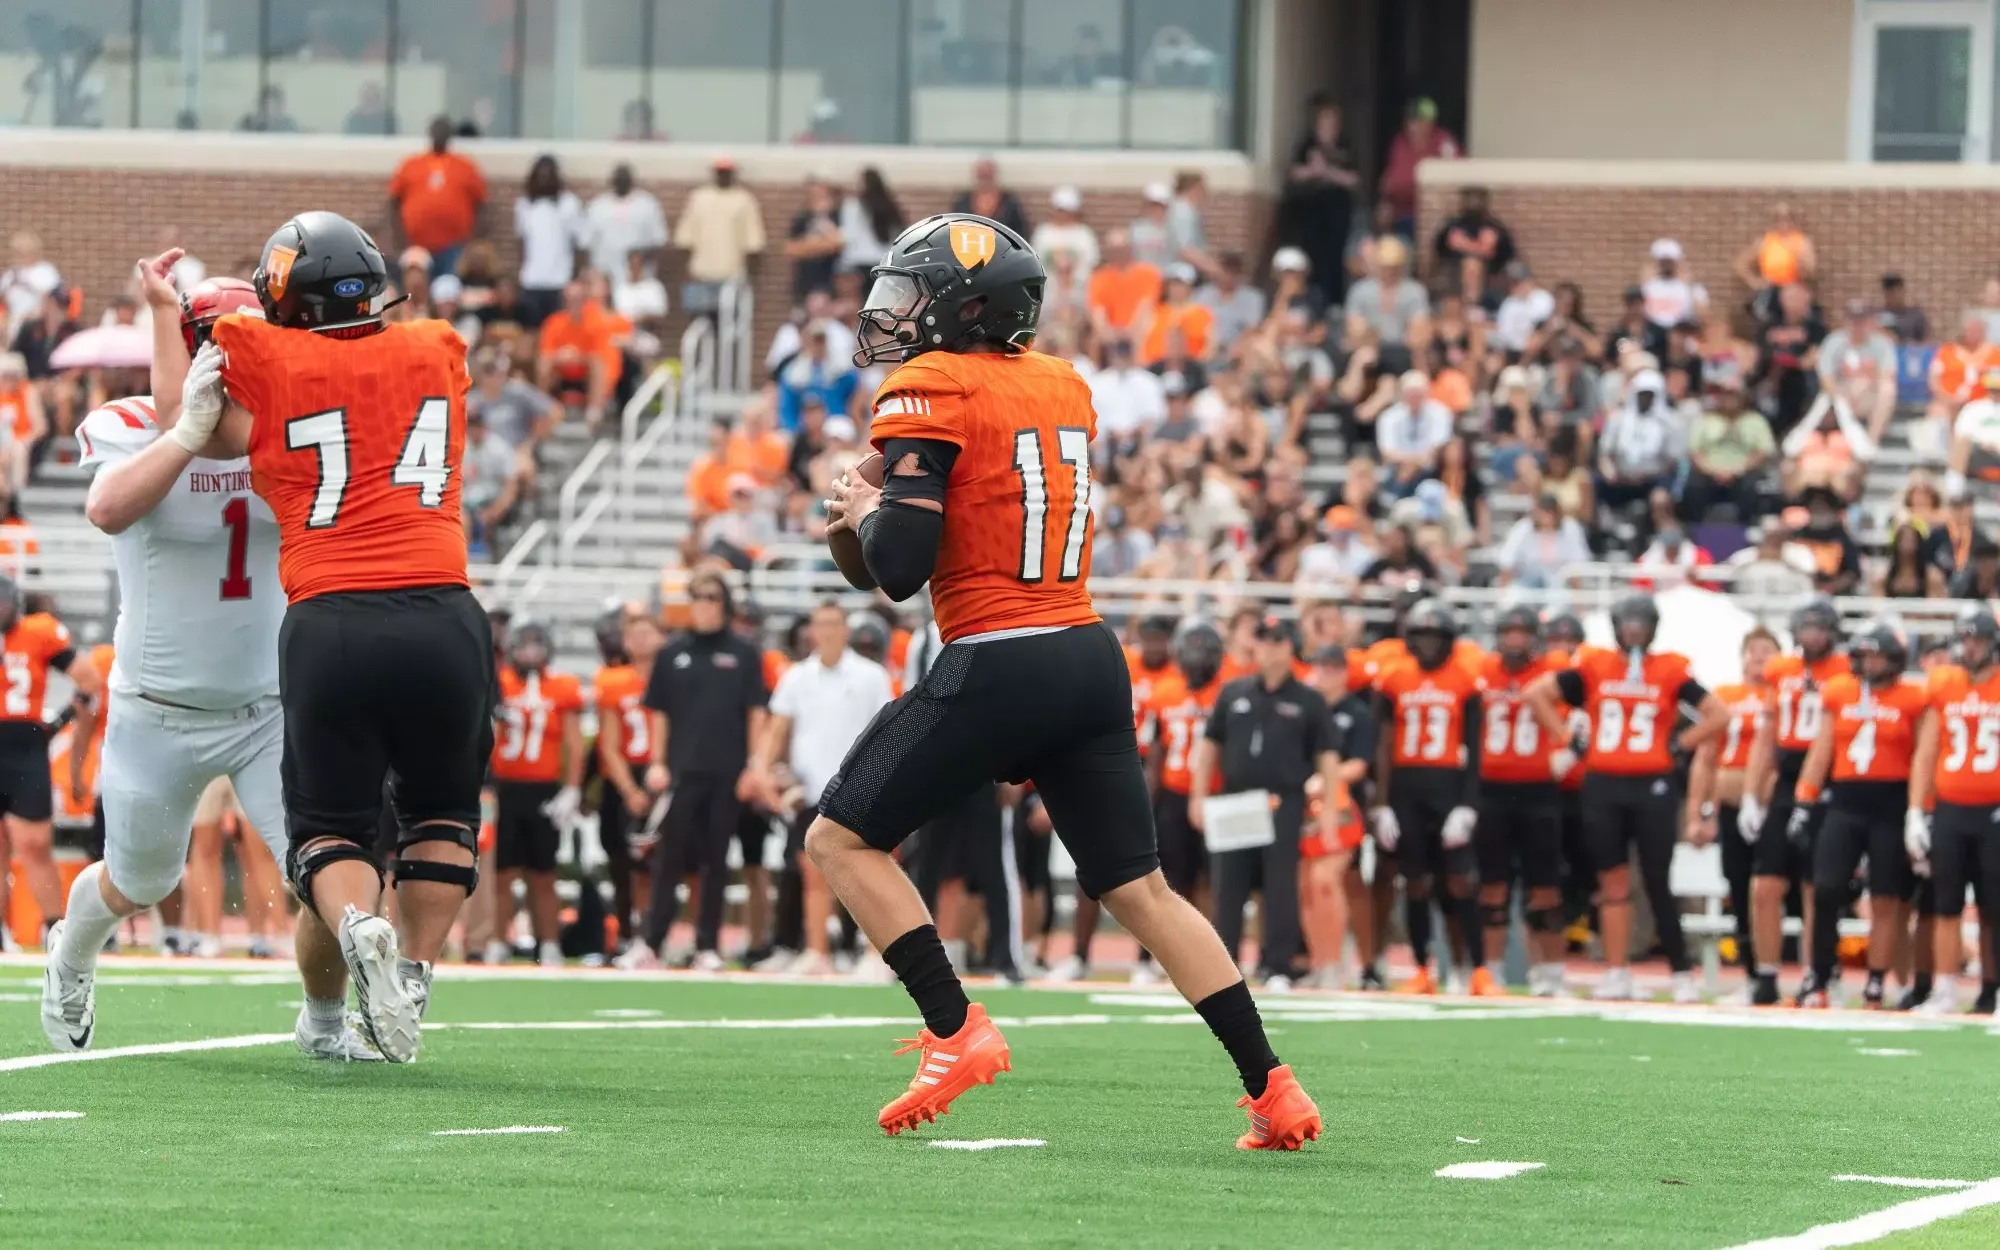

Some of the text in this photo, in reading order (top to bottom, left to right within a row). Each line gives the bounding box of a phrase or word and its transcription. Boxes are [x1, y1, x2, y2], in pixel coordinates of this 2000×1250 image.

[959, 231, 987, 257] H
[269, 261, 286, 287] H
[285, 396, 452, 530] 74
[1013, 425, 1091, 584] 17
[219, 497, 253, 601] 1
[1402, 705, 1450, 760] 13
[1847, 720, 1876, 776] 4
